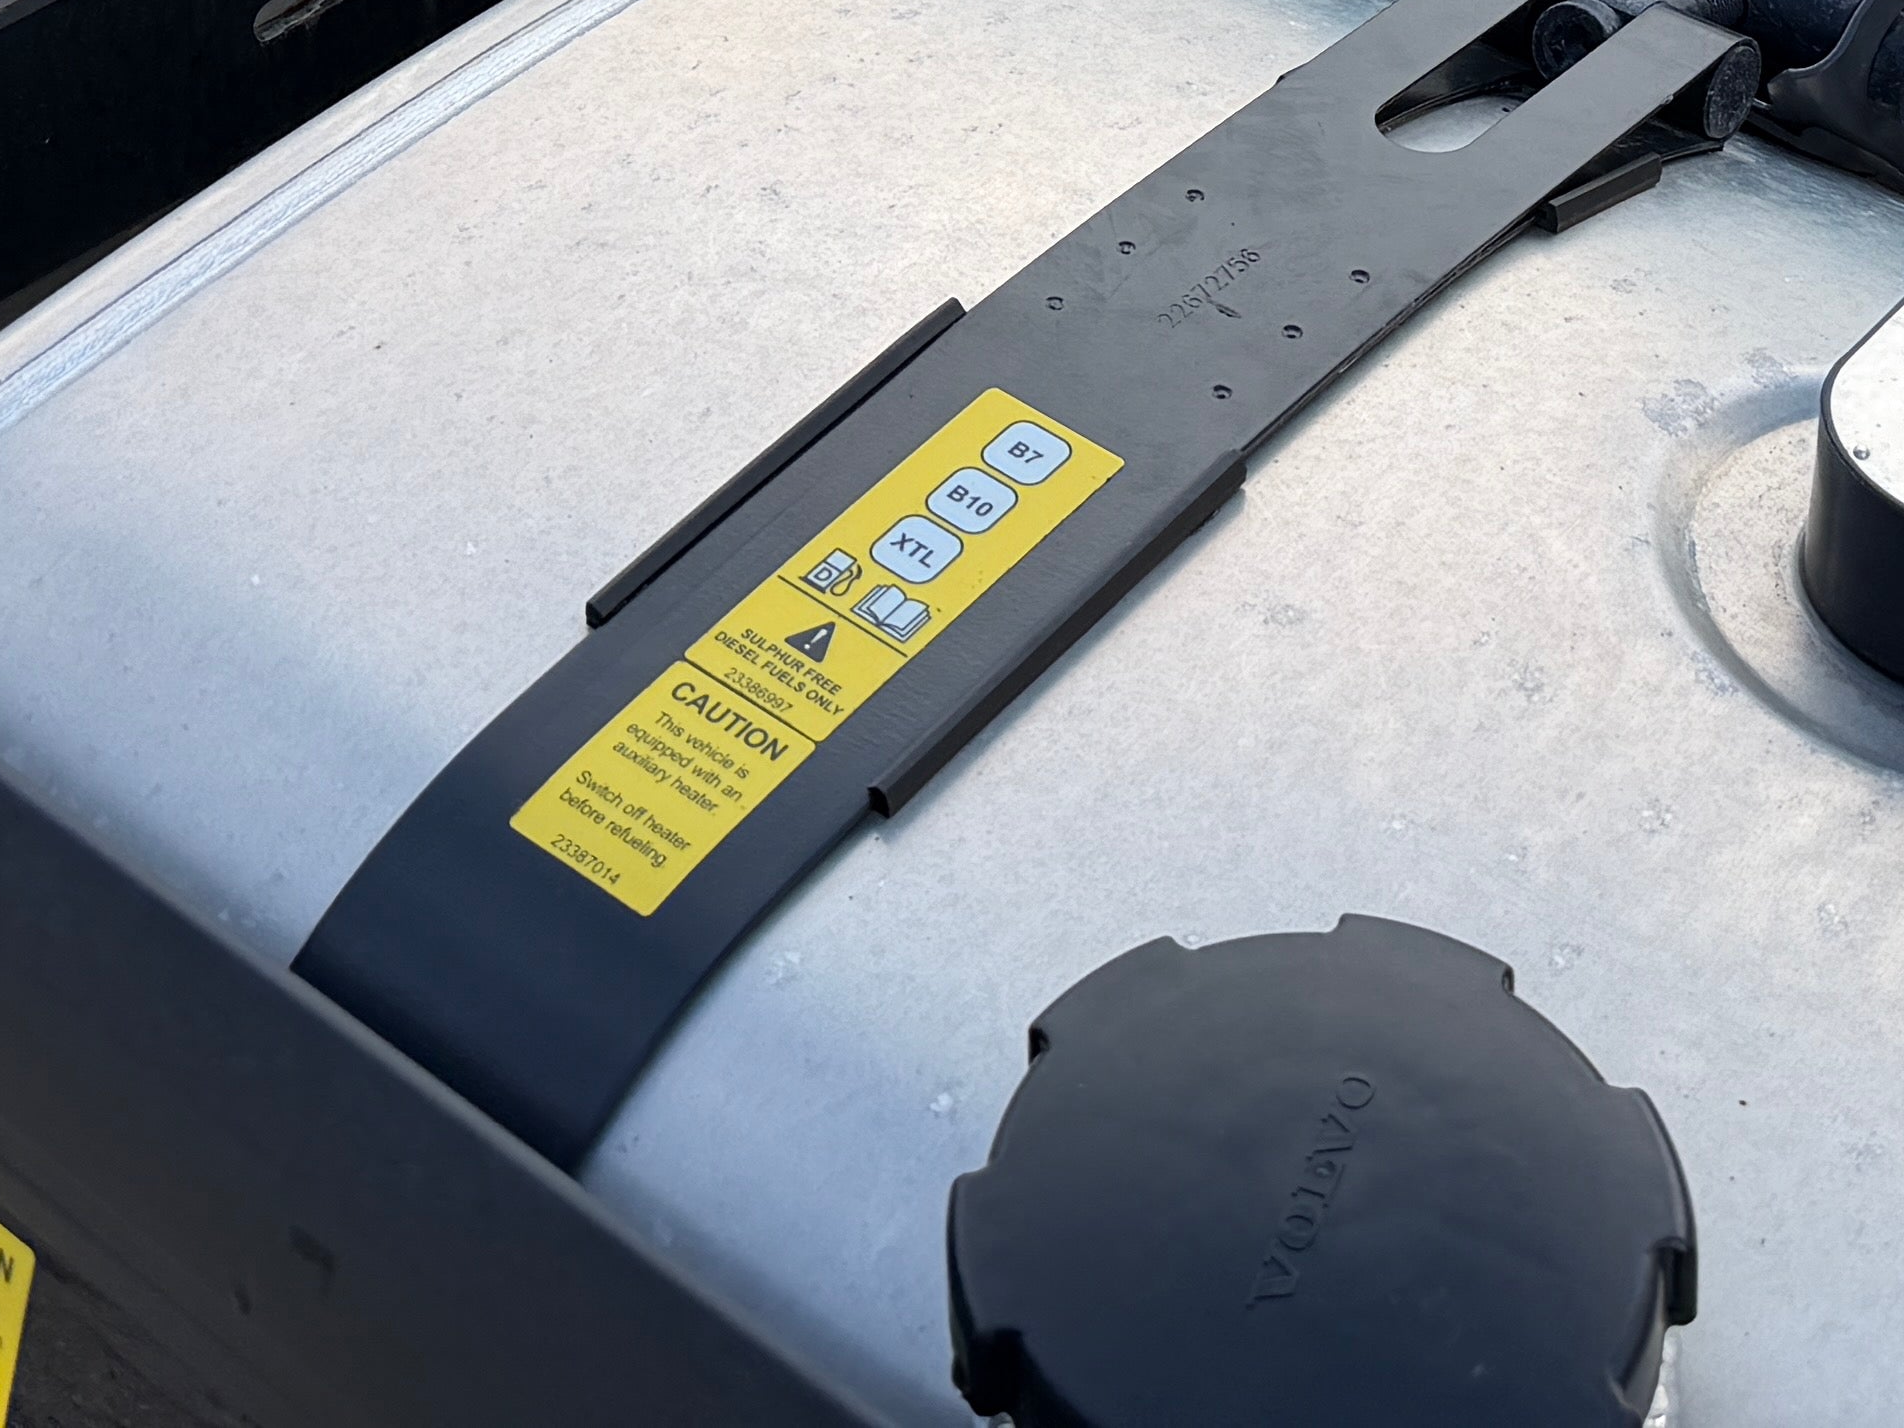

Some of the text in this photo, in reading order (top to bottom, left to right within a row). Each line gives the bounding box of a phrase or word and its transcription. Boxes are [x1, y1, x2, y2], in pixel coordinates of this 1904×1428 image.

[1157, 248, 1261, 328] 22672756
[1007, 441, 1044, 465] B7
[946, 484, 993, 518] B10
[890, 532, 934, 569] XTL
[714, 631, 845, 717] DIESEL FUELS ONLY
[723, 667, 794, 714] 23386997
[741, 628, 843, 696] SULPHUR FREE
[654, 710, 750, 780] This vehicle is
[671, 682, 789, 762] CAUTION
[613, 741, 673, 784] auxiliary
[626, 722, 743, 803] equipped with an
[559, 787, 607, 826] before
[575, 770, 692, 851] Switch off heater
[550, 834, 622, 885] 23387014
[1246, 1076, 1376, 1311] VOLVO
